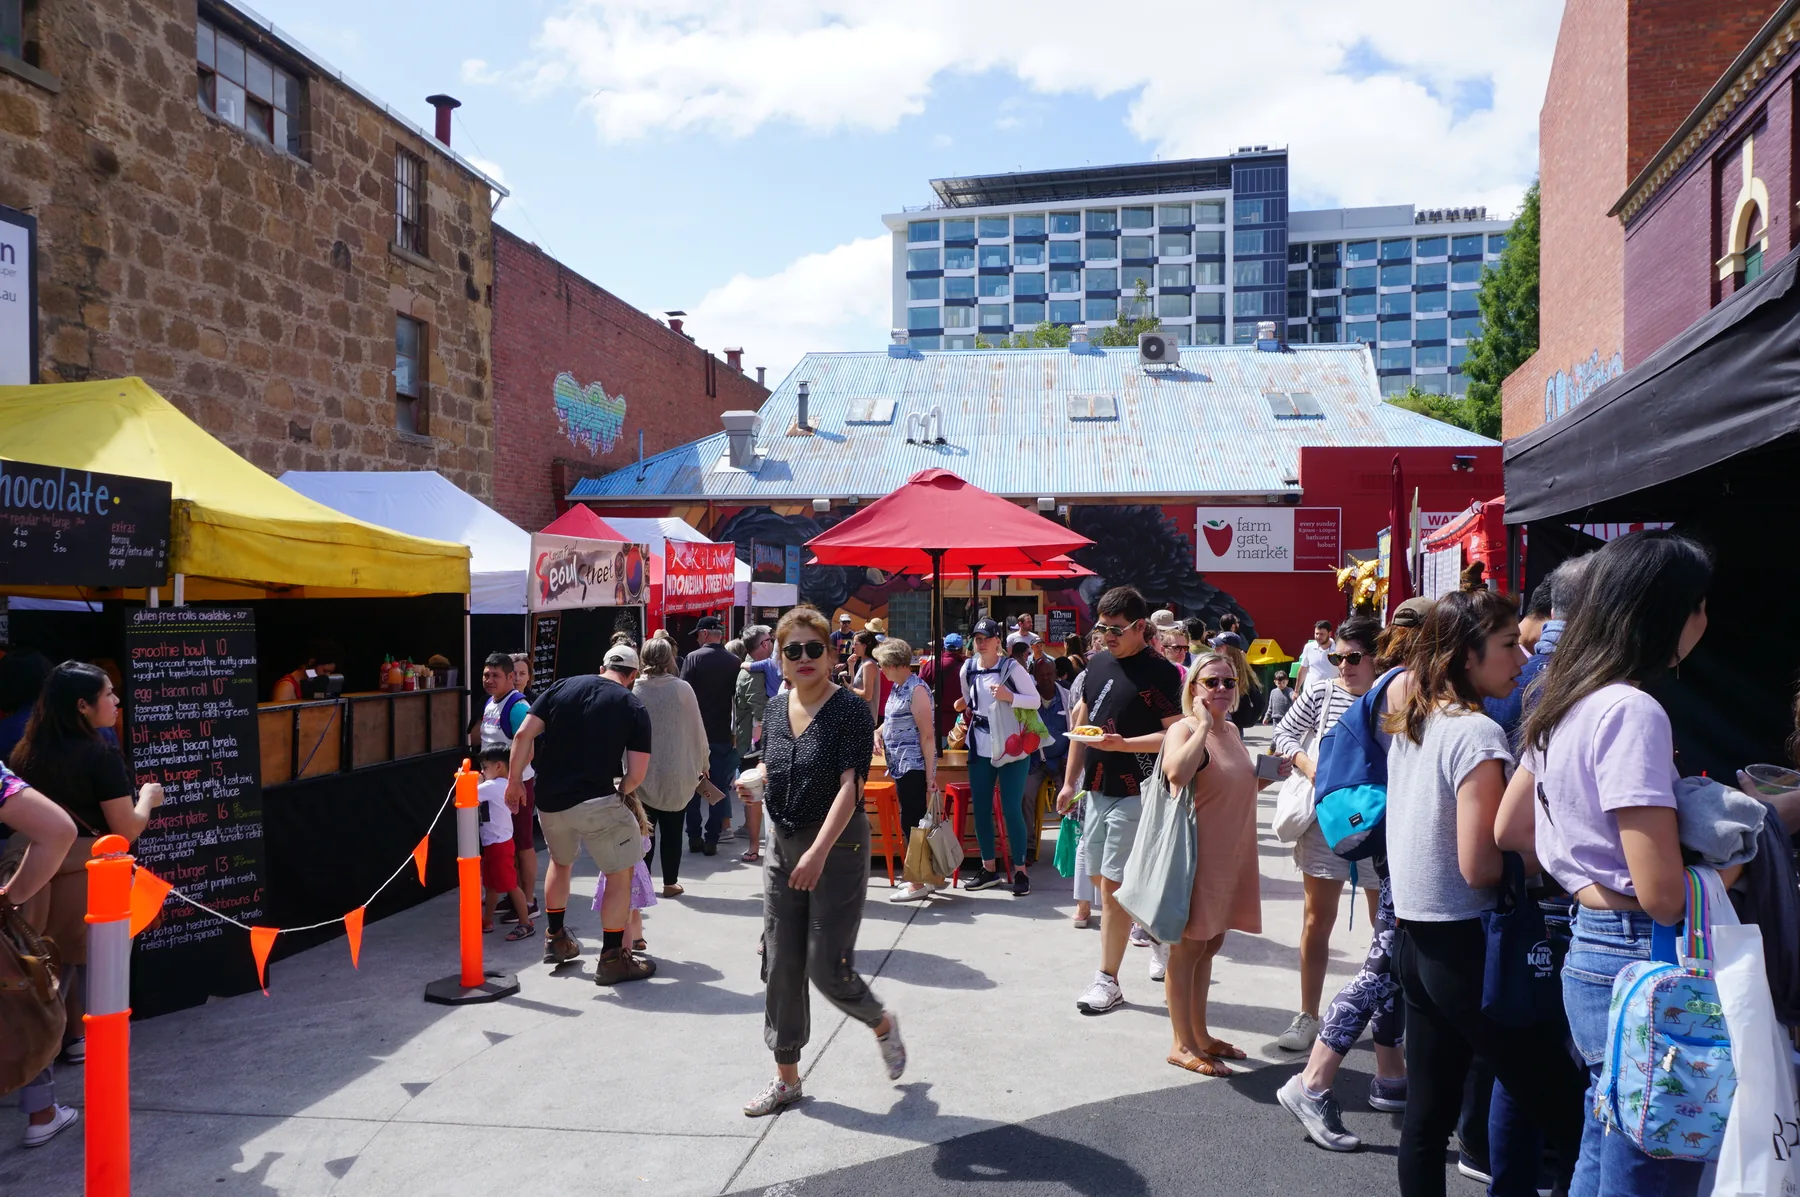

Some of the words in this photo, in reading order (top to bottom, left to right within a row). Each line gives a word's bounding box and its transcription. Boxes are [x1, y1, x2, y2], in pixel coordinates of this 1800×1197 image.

[52, 513, 70, 530] large
[112, 521, 136, 533] extras
[1237, 516, 1271, 532] farm
[54, 530, 61, 539] 5
[1236, 533, 1268, 548] gate
[1237, 544, 1288, 559] market
[535, 552, 578, 606] Seoul
[133, 610, 157, 625] gluten
[158, 611, 176, 625] free
[178, 610, 197, 620] rolls
[199, 610, 231, 620] available
[132, 641, 179, 658] smoothie
[183, 639, 206, 656] bowl
[216, 638, 227, 656] 10
[132, 659, 153, 673] berry
[188, 656, 216, 666] smoothie
[220, 656, 237, 668] nutty
[210, 665, 234, 676] berries
[134, 688, 152, 702] egg
[161, 683, 189, 698] bacon
[192, 682, 208, 696] roll
[134, 704, 174, 714] tasmanian
[134, 712, 174, 722] homemade
[175, 710, 200, 720] tomato
[202, 709, 220, 718] relish
[132, 724, 151, 744] blt
[160, 723, 192, 741] pickles
[133, 741, 178, 757] scottsdale
[134, 758, 159, 770] pickles
[161, 753, 187, 765] mustard
[211, 747, 238, 759] lettuce
[135, 769, 158, 785] lamb
[164, 768, 202, 782] burger
[211, 761, 224, 777] 13
[183, 779, 200, 792] lamb
[180, 789, 204, 803] relish
[212, 786, 240, 798] lettuce
[148, 812, 184, 832] eakfast
[186, 810, 209, 829] plate
[217, 802, 229, 820] 16
[219, 831, 244, 844] tomato
[246, 829, 263, 840] relish
[169, 848, 194, 862] spinach
[177, 863, 208, 882] burger
[215, 856, 229, 873] 13
[191, 879, 209, 891] roast
[210, 875, 236, 892] pumpkin
[172, 904, 196, 920] made
[153, 924, 182, 939] potato
[241, 908, 263, 920] tomato
[140, 938, 166, 951] relish
[193, 925, 222, 943] spinach
